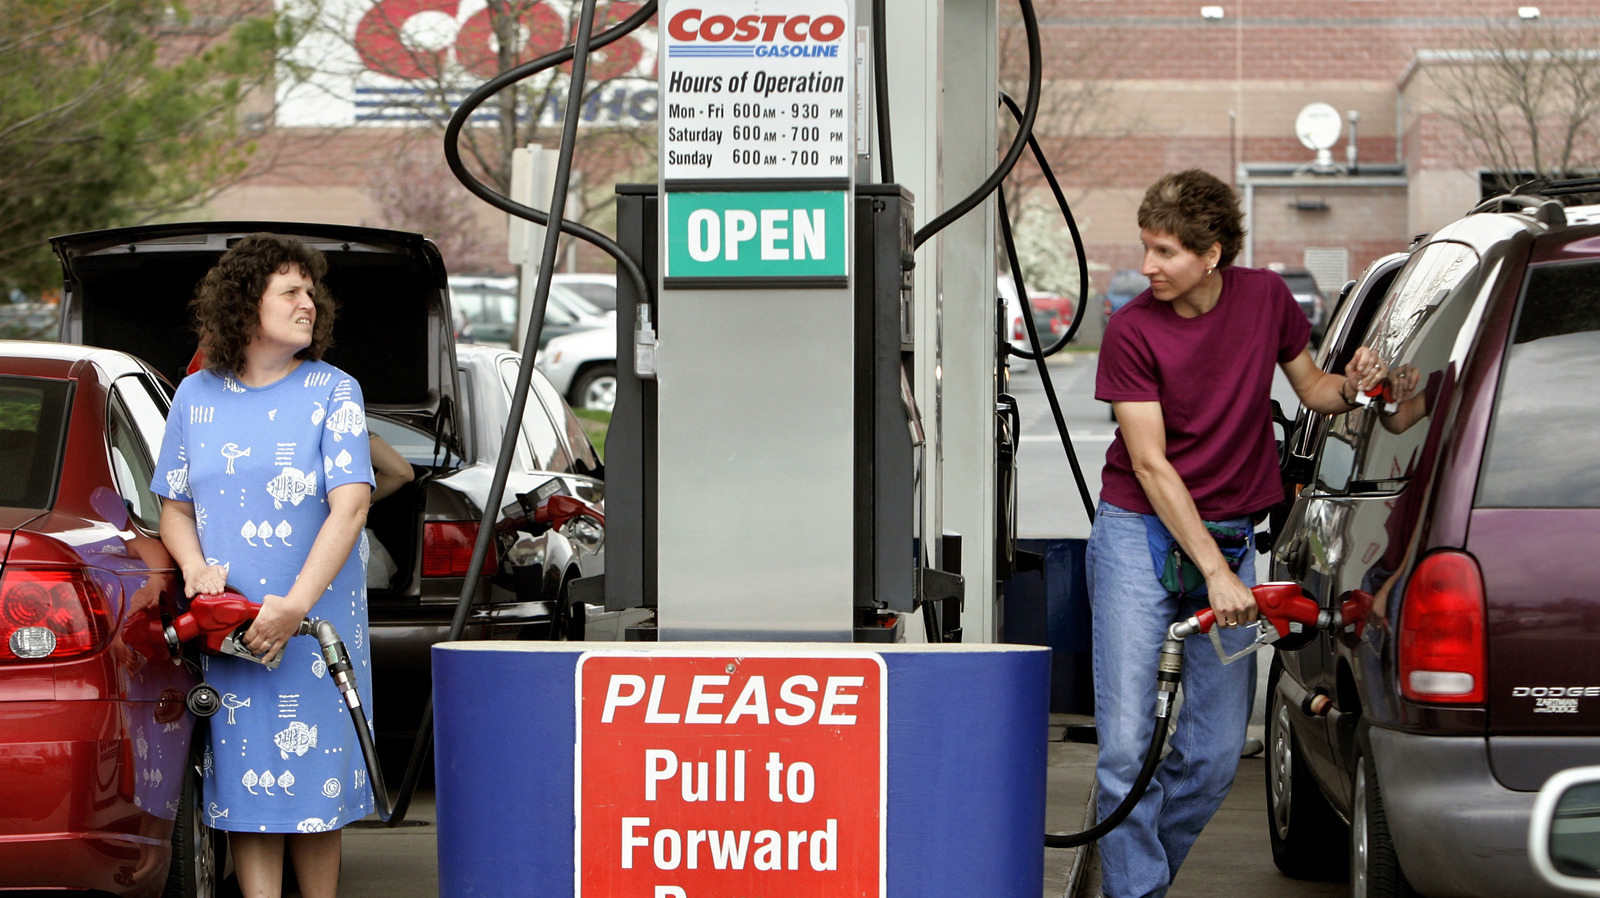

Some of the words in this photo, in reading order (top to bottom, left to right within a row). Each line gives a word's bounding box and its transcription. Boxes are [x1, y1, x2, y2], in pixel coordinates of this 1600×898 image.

[668, 9, 845, 42] COSTCO
[755, 45, 839, 58] GASOLINE
[669, 71, 722, 93] Hours
[728, 71, 749, 93] of
[753, 71, 844, 97] Operation
[669, 104, 695, 118] Mon
[708, 104, 724, 118] Fri
[791, 104, 819, 119] 930
[830, 109, 843, 118] PM
[669, 127, 722, 145] Saturday
[791, 126, 820, 141] 700
[830, 132, 843, 141] PM
[669, 150, 713, 168] Sunday
[791, 151, 819, 165] 700
[830, 156, 843, 165] PM
[687, 208, 826, 262] OPEN
[601, 674, 865, 726] PLEASE
[1511, 687, 1600, 697] DODGE
[645, 749, 745, 802] Pull
[765, 752, 815, 803] to
[621, 817, 837, 871] Forward
